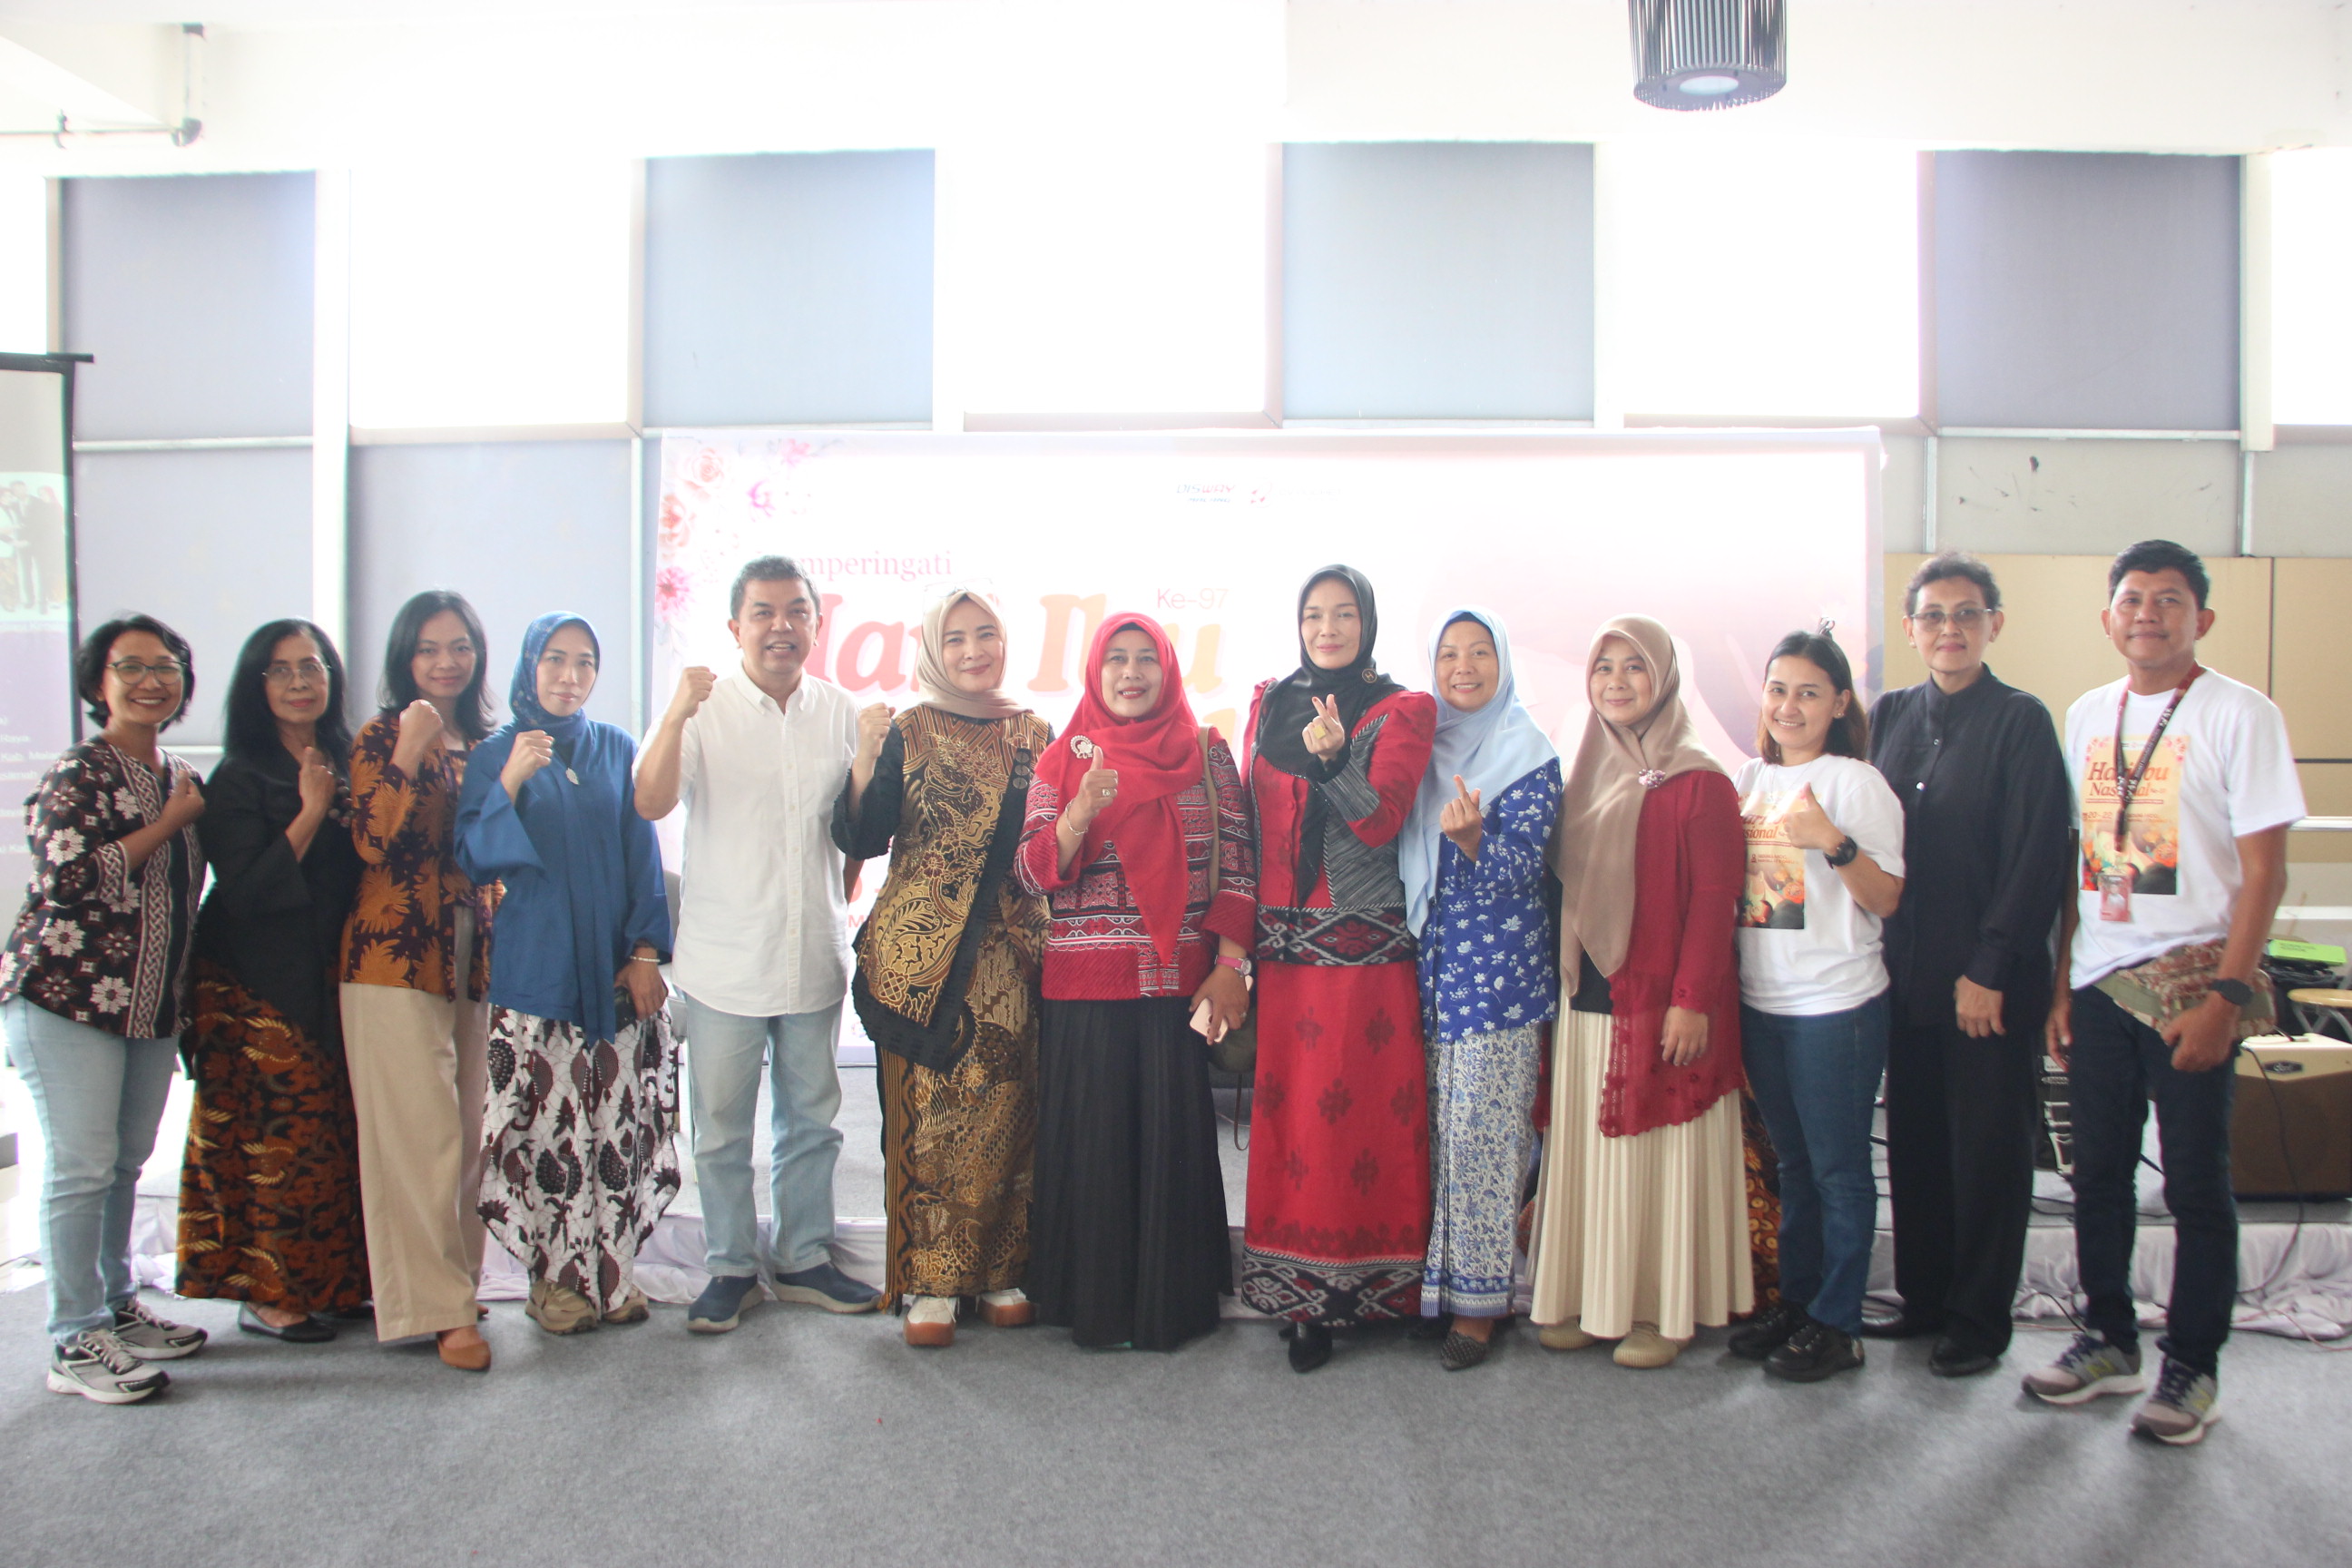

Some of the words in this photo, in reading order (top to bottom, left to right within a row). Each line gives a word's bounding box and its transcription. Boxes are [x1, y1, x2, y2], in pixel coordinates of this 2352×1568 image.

[1176, 484, 1236, 495] DISWAY
[799, 551, 952, 582] mperingati
[1156, 587, 1230, 611] Ke-97
[2087, 762, 2137, 781] Hai
[2090, 782, 2151, 798] Nasal
[1742, 825, 1779, 839] sional
